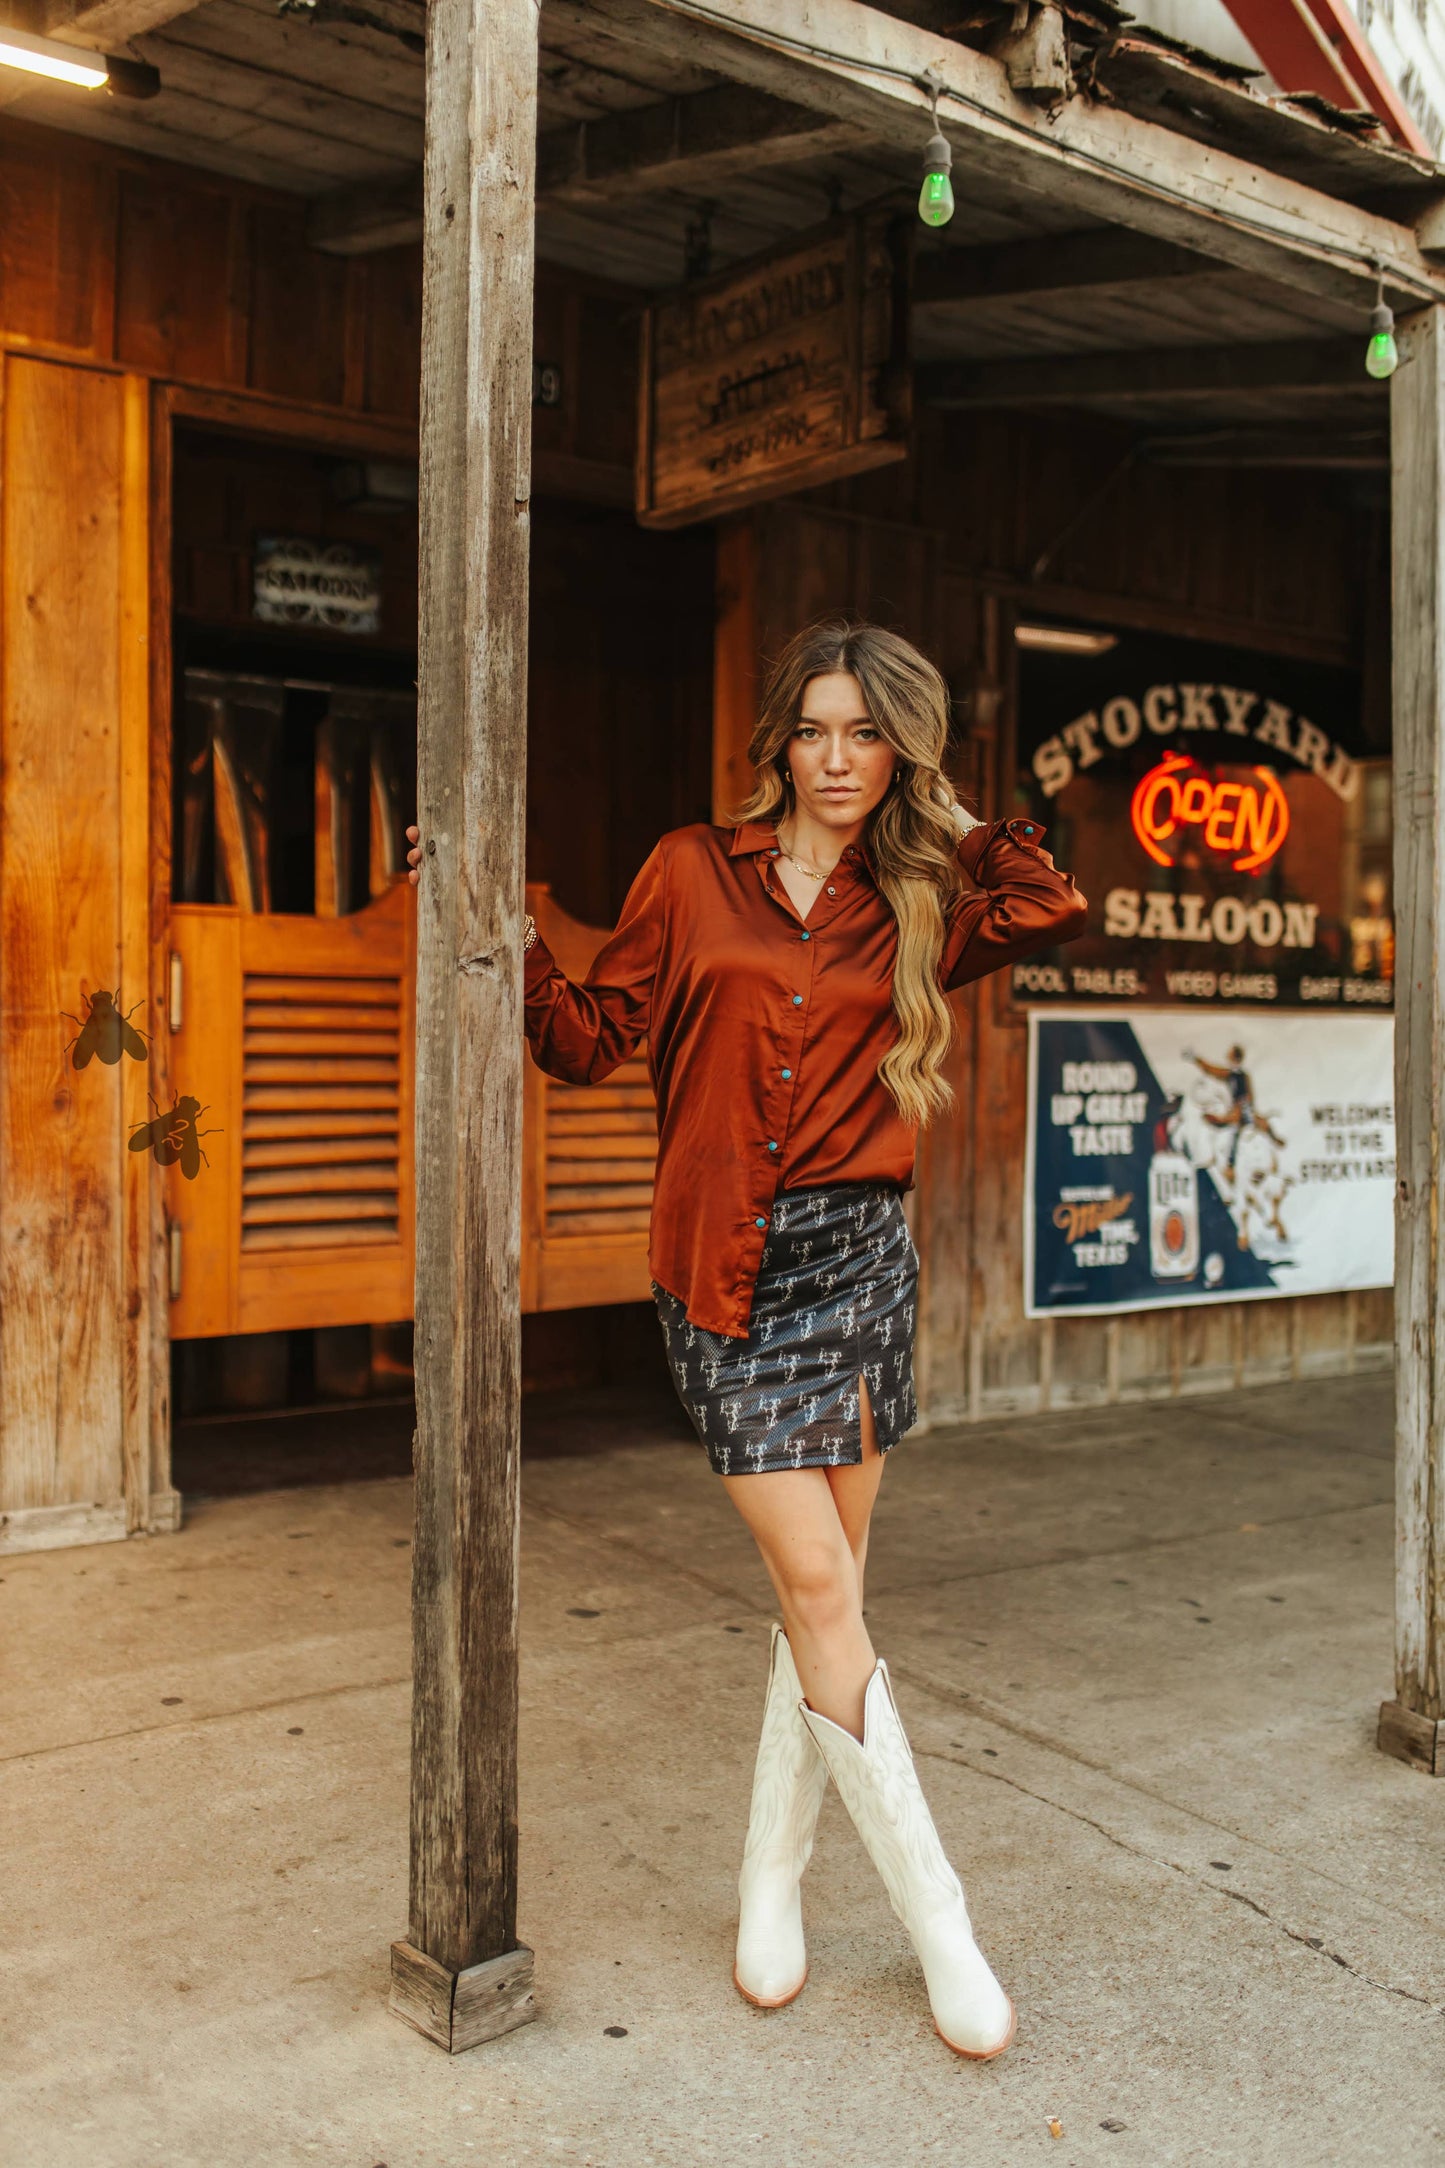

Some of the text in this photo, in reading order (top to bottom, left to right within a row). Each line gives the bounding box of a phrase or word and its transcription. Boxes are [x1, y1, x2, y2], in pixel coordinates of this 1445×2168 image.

[266, 568, 368, 600] SALOON
[1032, 683, 1360, 802] STOCKYARD
[1142, 776, 1276, 854] OPEN
[1104, 888, 1320, 949] SALOON
[1013, 965, 1068, 993] POOL
[1165, 970, 1217, 998] VIDEO
[1219, 972, 1278, 1000] GAMES
[1062, 1061, 1137, 1094] ROUND
[1051, 1092, 1148, 1126] UP GREAT
[1310, 1102, 1394, 1128] WELCOME
[1069, 1124, 1133, 1156] TASTE
[1324, 1130, 1384, 1154] TO THE
[1155, 1172, 1192, 1206] Lite
[1073, 1243, 1129, 1268] TEXAS
